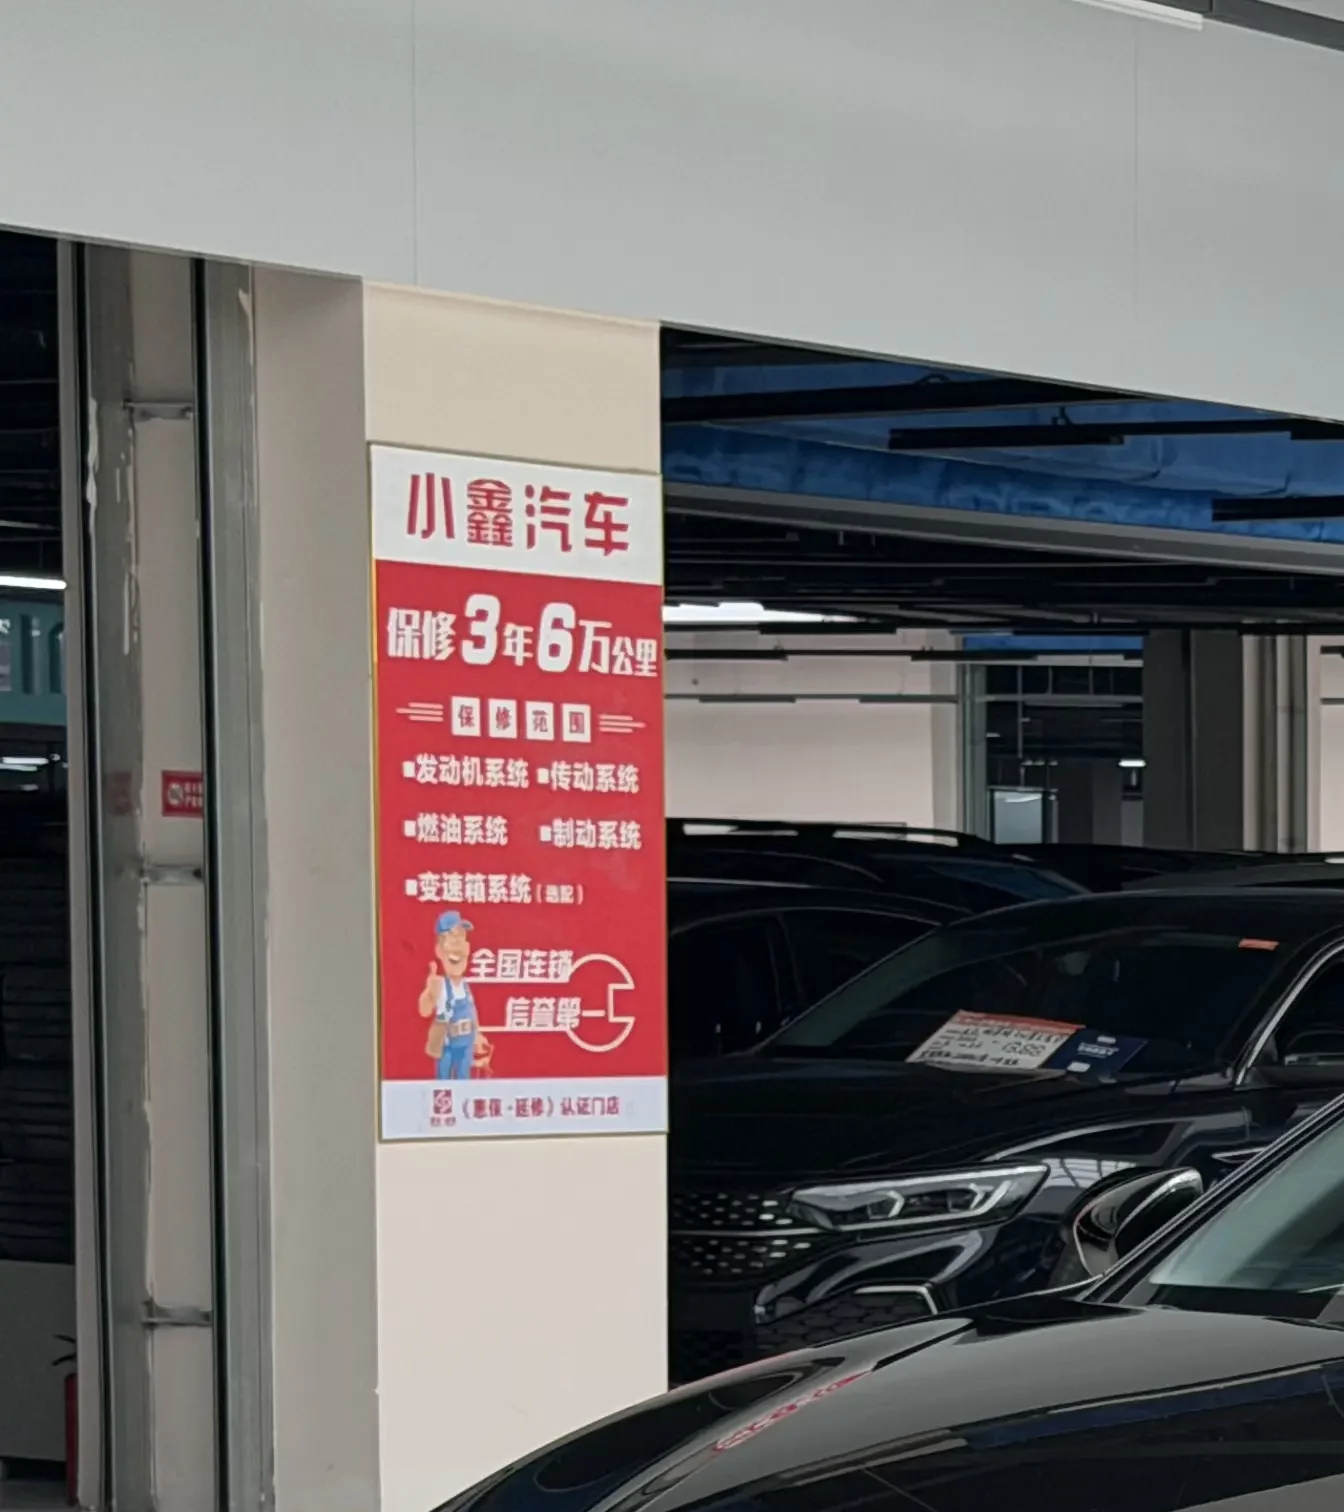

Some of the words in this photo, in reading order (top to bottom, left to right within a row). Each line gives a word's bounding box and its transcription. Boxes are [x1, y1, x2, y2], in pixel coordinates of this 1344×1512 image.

[406, 472, 630, 556] 小鑫汽车
[386, 593, 658, 677] 保修3年6万公里
[415, 752, 530, 789] 发动机系统
[549, 760, 640, 794] 传动系统
[416, 813, 508, 845] 燃油系统
[552, 818, 642, 850] 制动系统
[417, 871, 532, 904] 变速箱系统
